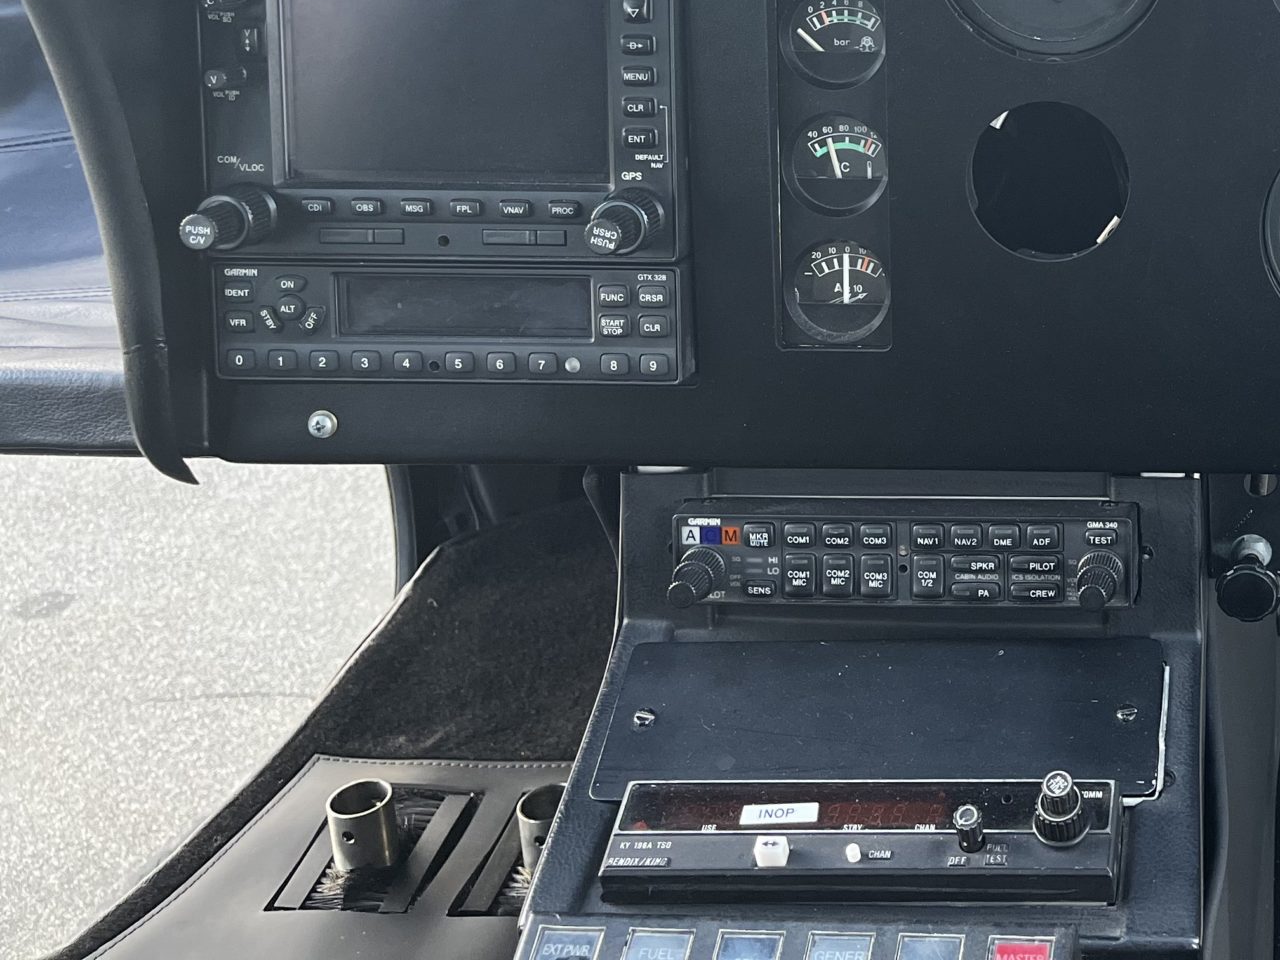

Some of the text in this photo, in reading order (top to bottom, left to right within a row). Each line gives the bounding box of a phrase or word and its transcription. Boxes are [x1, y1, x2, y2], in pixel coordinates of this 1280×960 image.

[834, 38, 850, 46] bar
[624, 73, 648, 81] MENU
[627, 104, 644, 112] CLR
[628, 135, 645, 143] ENT
[621, 172, 642, 181] GPS
[356, 204, 373, 212] OBS
[405, 204, 423, 213] MSG
[456, 205, 472, 213] FPL
[503, 206, 524, 214] VNAV
[552, 207, 574, 215] PROC
[186, 226, 210, 235] PUSH
[190, 236, 206, 244] C/V
[224, 268, 257, 277] GARMIN
[225, 289, 249, 297] IDENT
[600, 293, 624, 302] FUNC
[640, 294, 663, 302] CRSR
[280, 305, 295, 313] ALT
[260, 309, 276, 330] STBY
[644, 324, 660, 332] CLR
[787, 536, 810, 544] COM1
[825, 537, 849, 545] COM2
[955, 538, 977, 546] NAV2
[994, 538, 1012, 546] DME
[1033, 538, 1051, 546] ADF
[971, 562, 994, 571] SPKR
[826, 570, 850, 578] COM2
[864, 572, 888, 580] COM3
[918, 571, 936, 579] COM
[869, 580, 883, 588] MIC
[759, 808, 795, 819] INOP
[869, 851, 891, 859] CHAN
[543, 944, 591, 956] EXT PWR
[639, 948, 674, 959] FUEL
